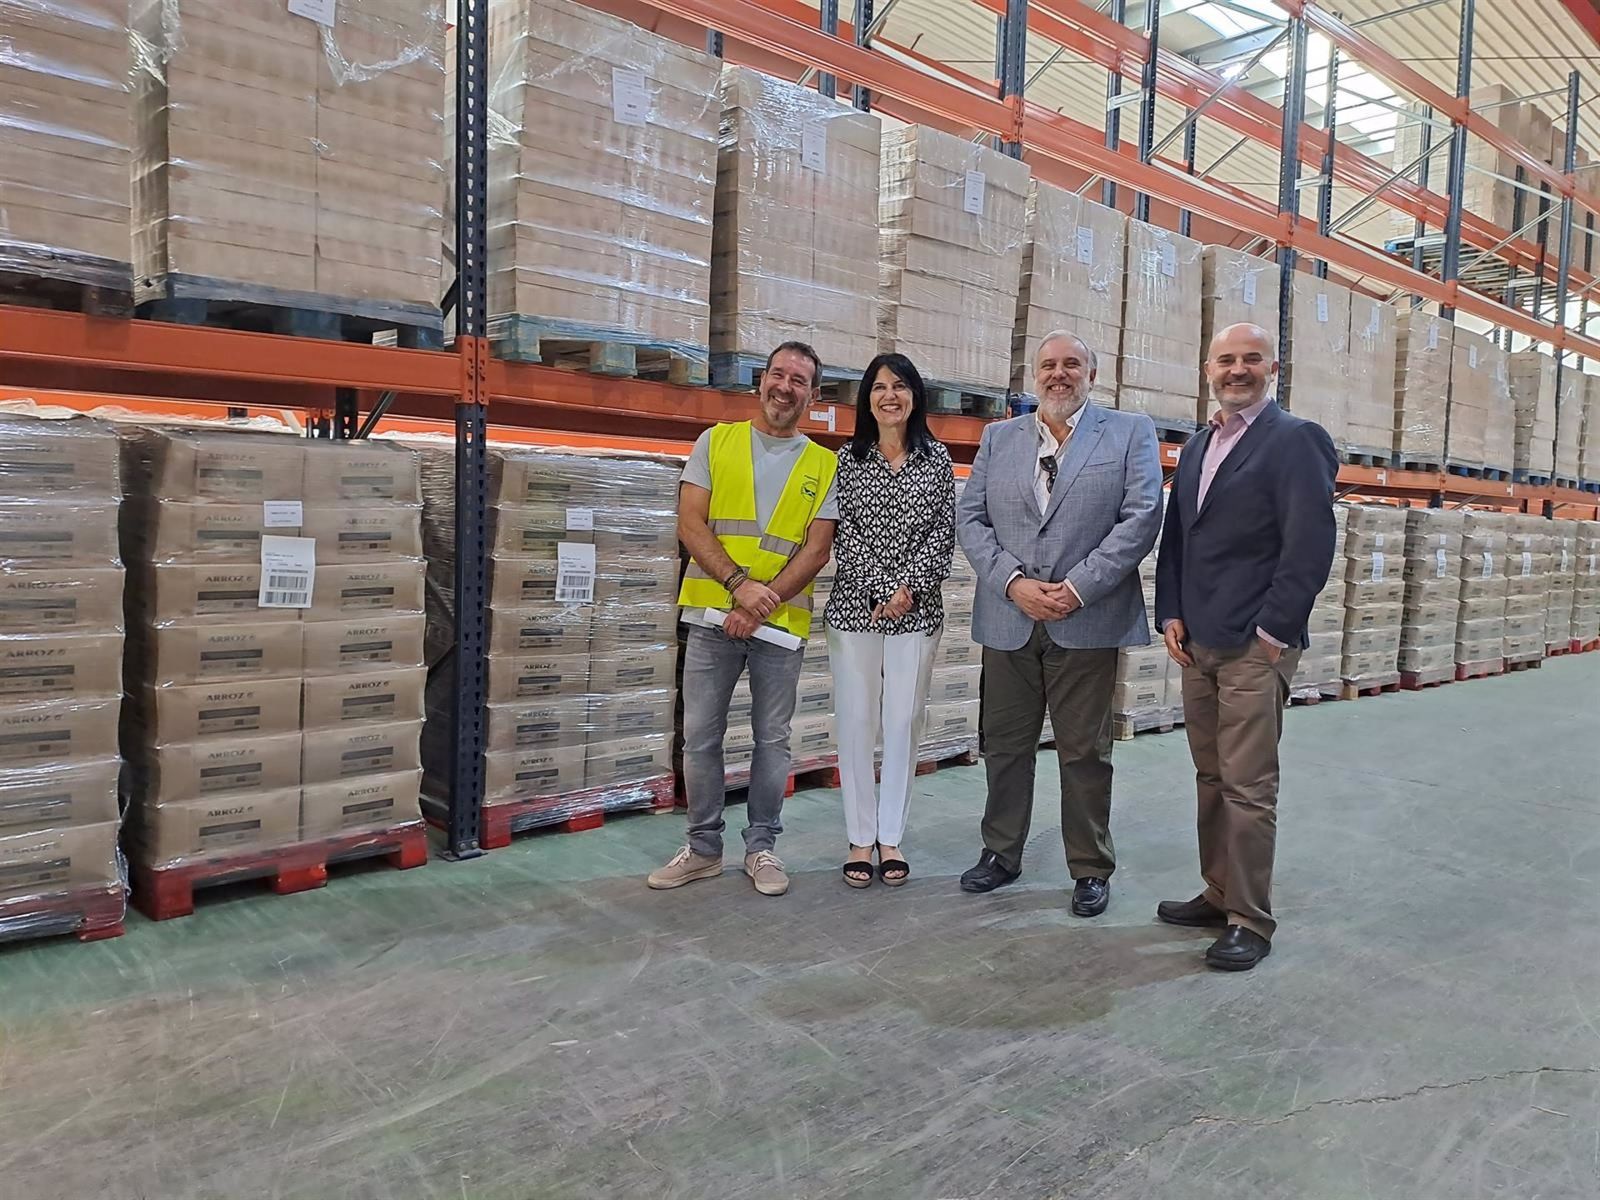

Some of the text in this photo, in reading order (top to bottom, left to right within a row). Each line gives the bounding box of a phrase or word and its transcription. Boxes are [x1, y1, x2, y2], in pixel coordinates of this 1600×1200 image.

[205, 575, 244, 583] ARROZ
[346, 628, 379, 637] ARROZ
[207, 635, 247, 644] ARROZ
[5, 650, 55, 658] ARROZ
[348, 681, 382, 690] ARROZ
[206, 692, 245, 702] ARROZ
[2, 714, 52, 725] ARROZ
[208, 750, 246, 760] ARROZ
[347, 786, 380, 798] ARROZ
[207, 807, 246, 818] ARROZ
